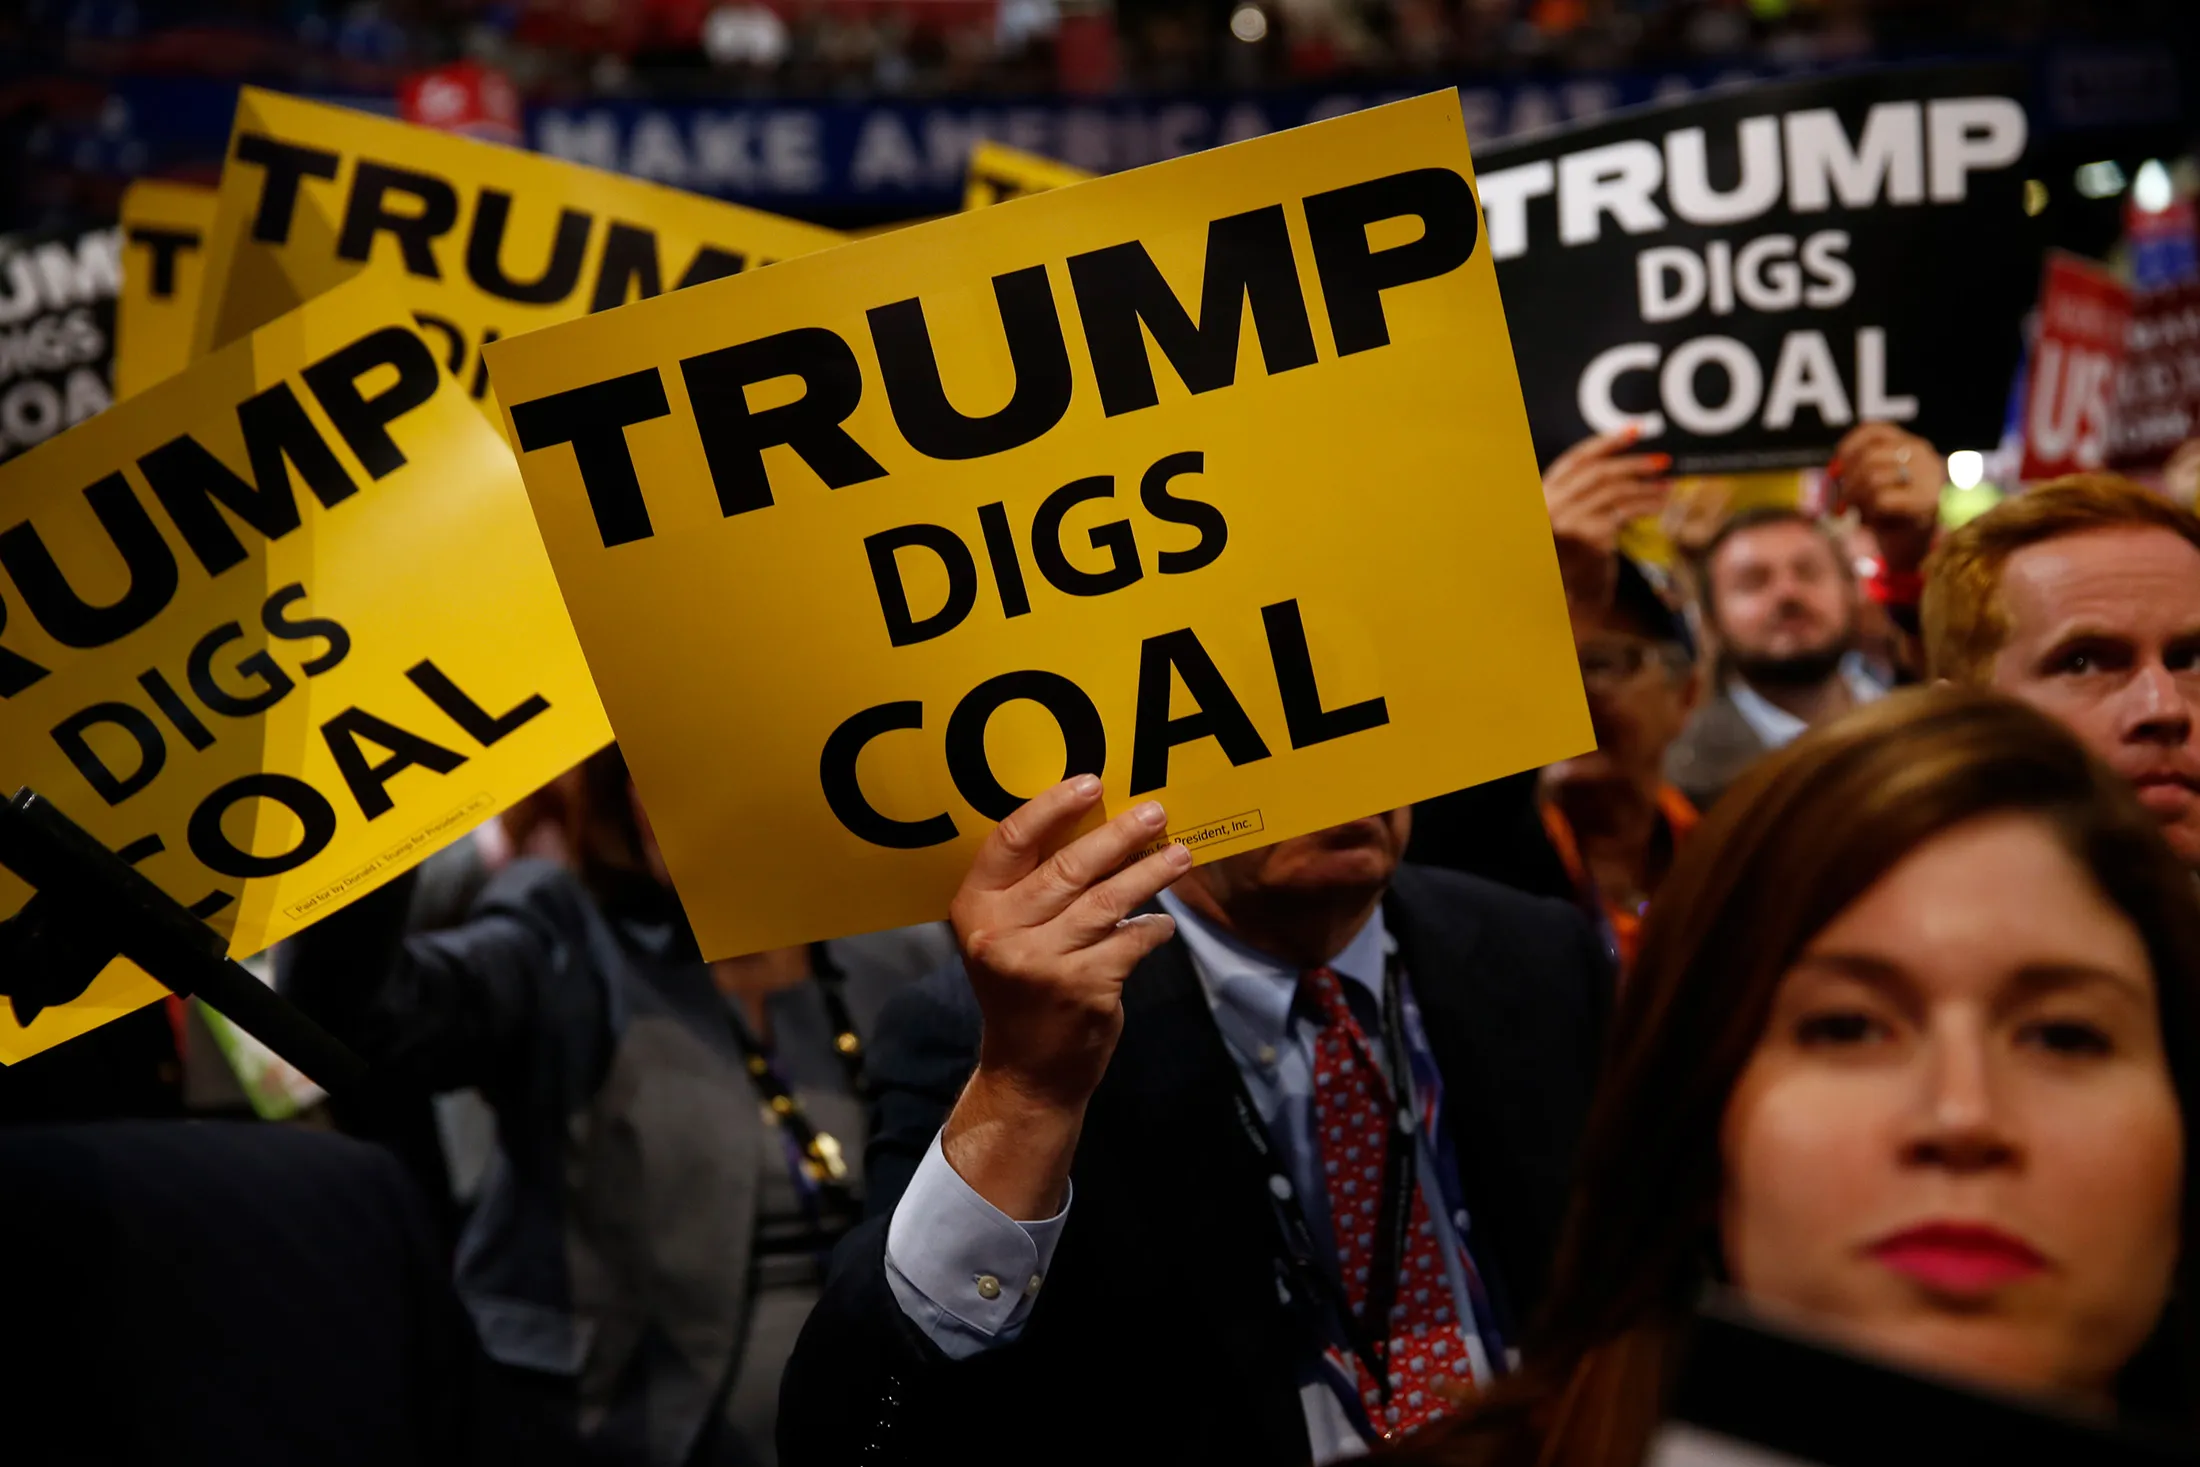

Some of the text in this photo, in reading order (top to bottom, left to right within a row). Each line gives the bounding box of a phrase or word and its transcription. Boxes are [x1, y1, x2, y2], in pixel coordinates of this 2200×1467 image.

[237, 132, 780, 314] TRUM
[536, 107, 822, 191] MAKE
[1475, 96, 2027, 261] TRUMP
[510, 167, 1478, 548] TRUMP
[1636, 230, 1855, 322] DIGS
[1578, 327, 1918, 438] COAL
[863, 451, 1228, 647] DIGS
[50, 582, 351, 806] DIGS
[820, 598, 1389, 849] COAL
[295, 898, 318, 913] Paid
[315, 891, 331, 901] for
[329, 883, 346, 894] by
[342, 863, 378, 886] Donald
[382, 841, 414, 862] Trump
[410, 833, 425, 844] for
[1231, 818, 1252, 832] Inc.
